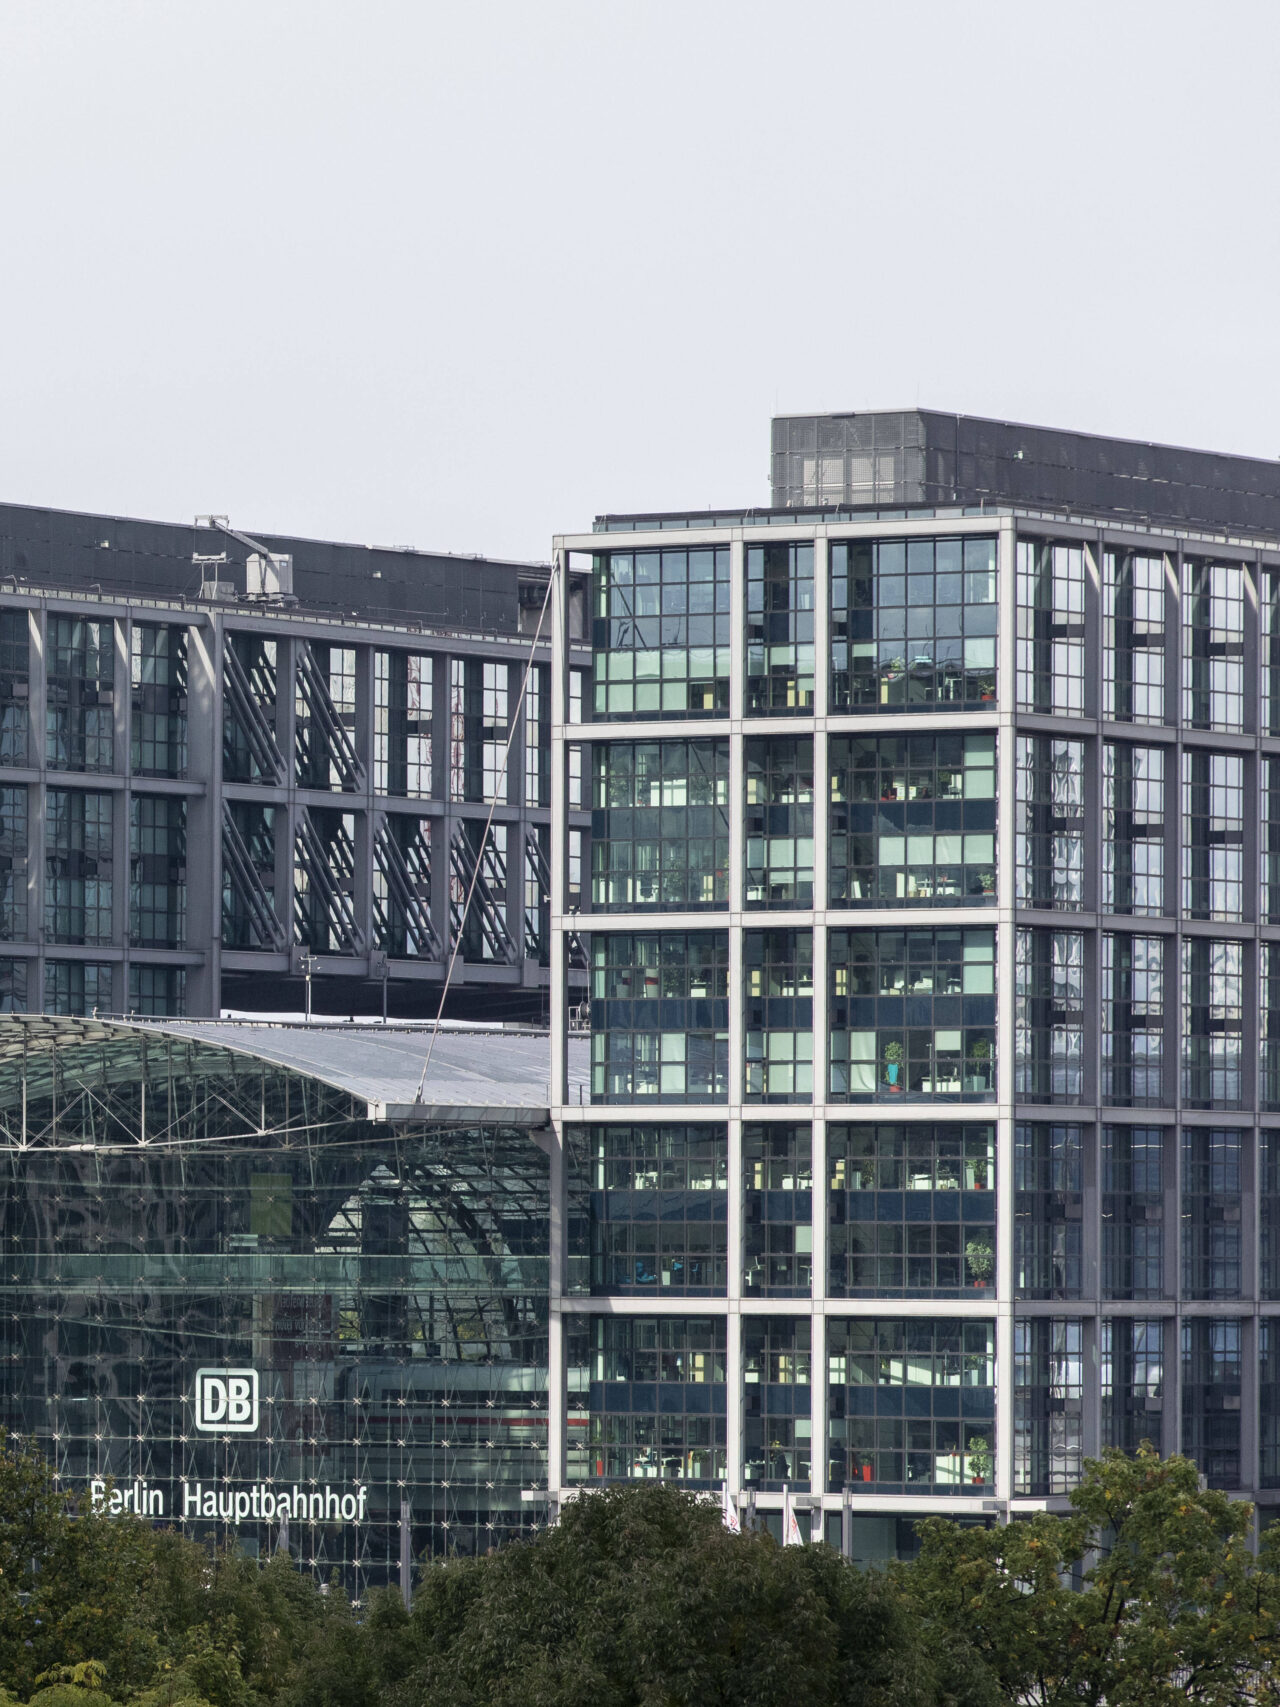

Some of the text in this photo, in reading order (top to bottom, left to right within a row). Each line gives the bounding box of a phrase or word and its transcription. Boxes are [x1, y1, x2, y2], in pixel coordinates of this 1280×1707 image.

[203, 1378, 251, 1421] DB
[91, 1481, 367, 1525] Berlin Hauptbahnhof
